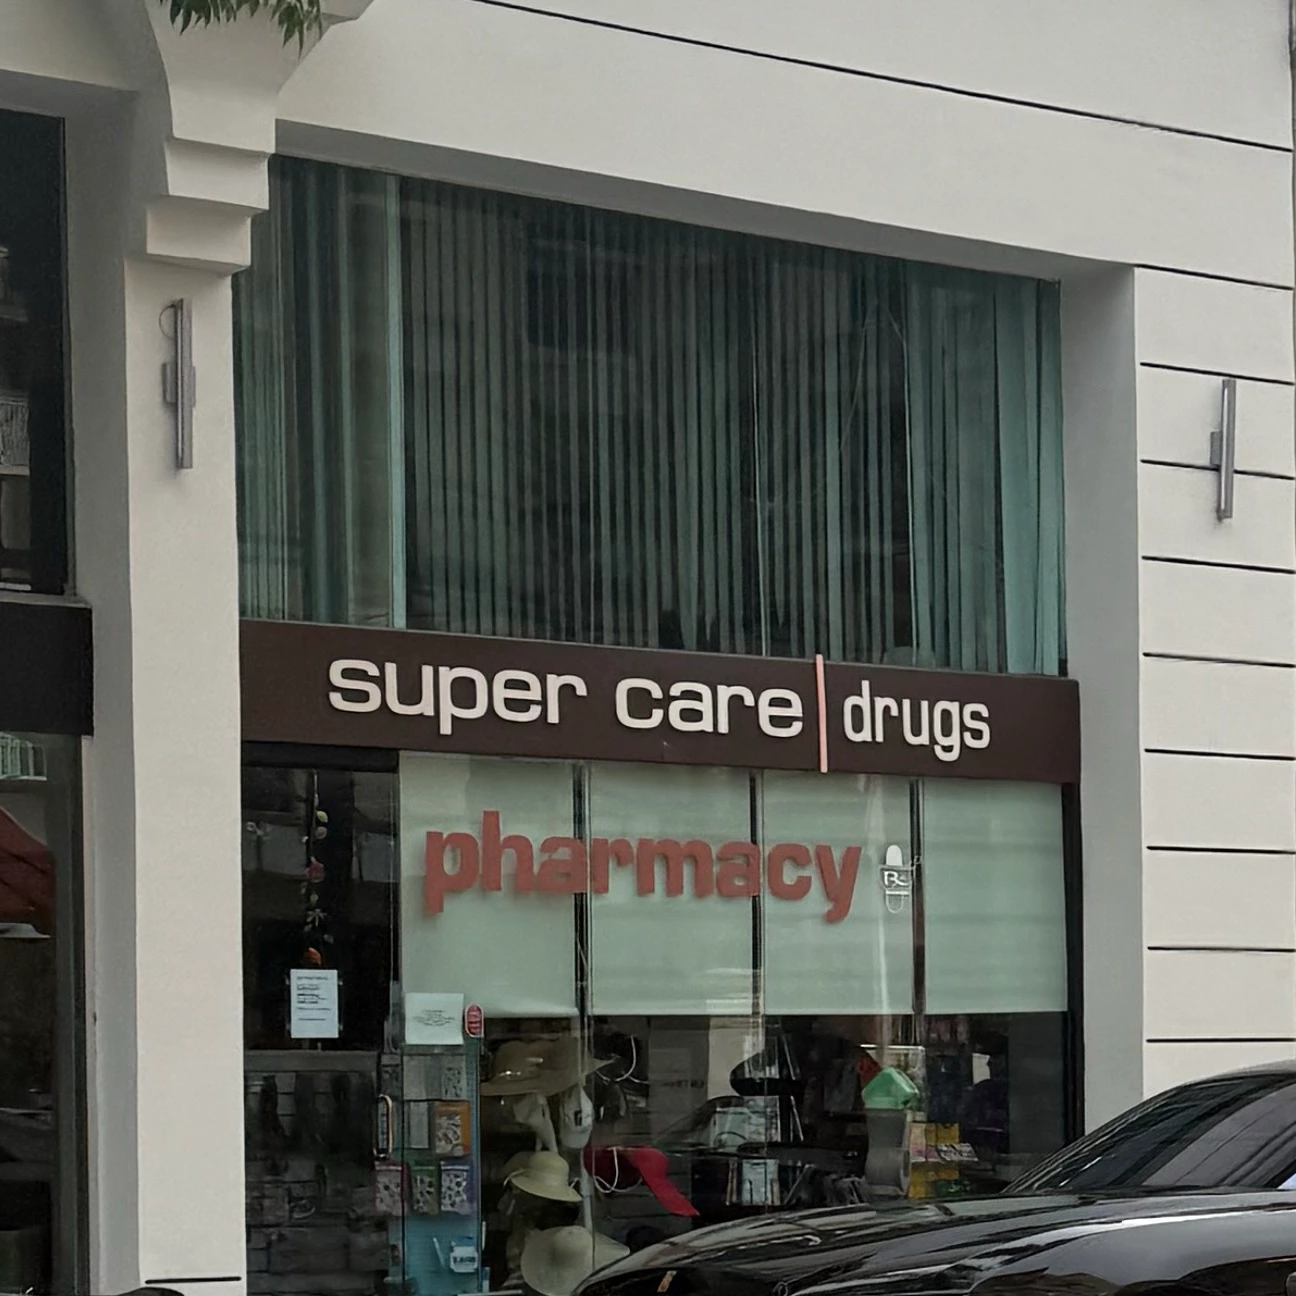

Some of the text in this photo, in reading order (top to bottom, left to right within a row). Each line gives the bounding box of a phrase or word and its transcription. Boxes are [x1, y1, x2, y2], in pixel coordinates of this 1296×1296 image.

[329, 659, 993, 762] super care drugs
[424, 810, 862, 924] pharmacy
